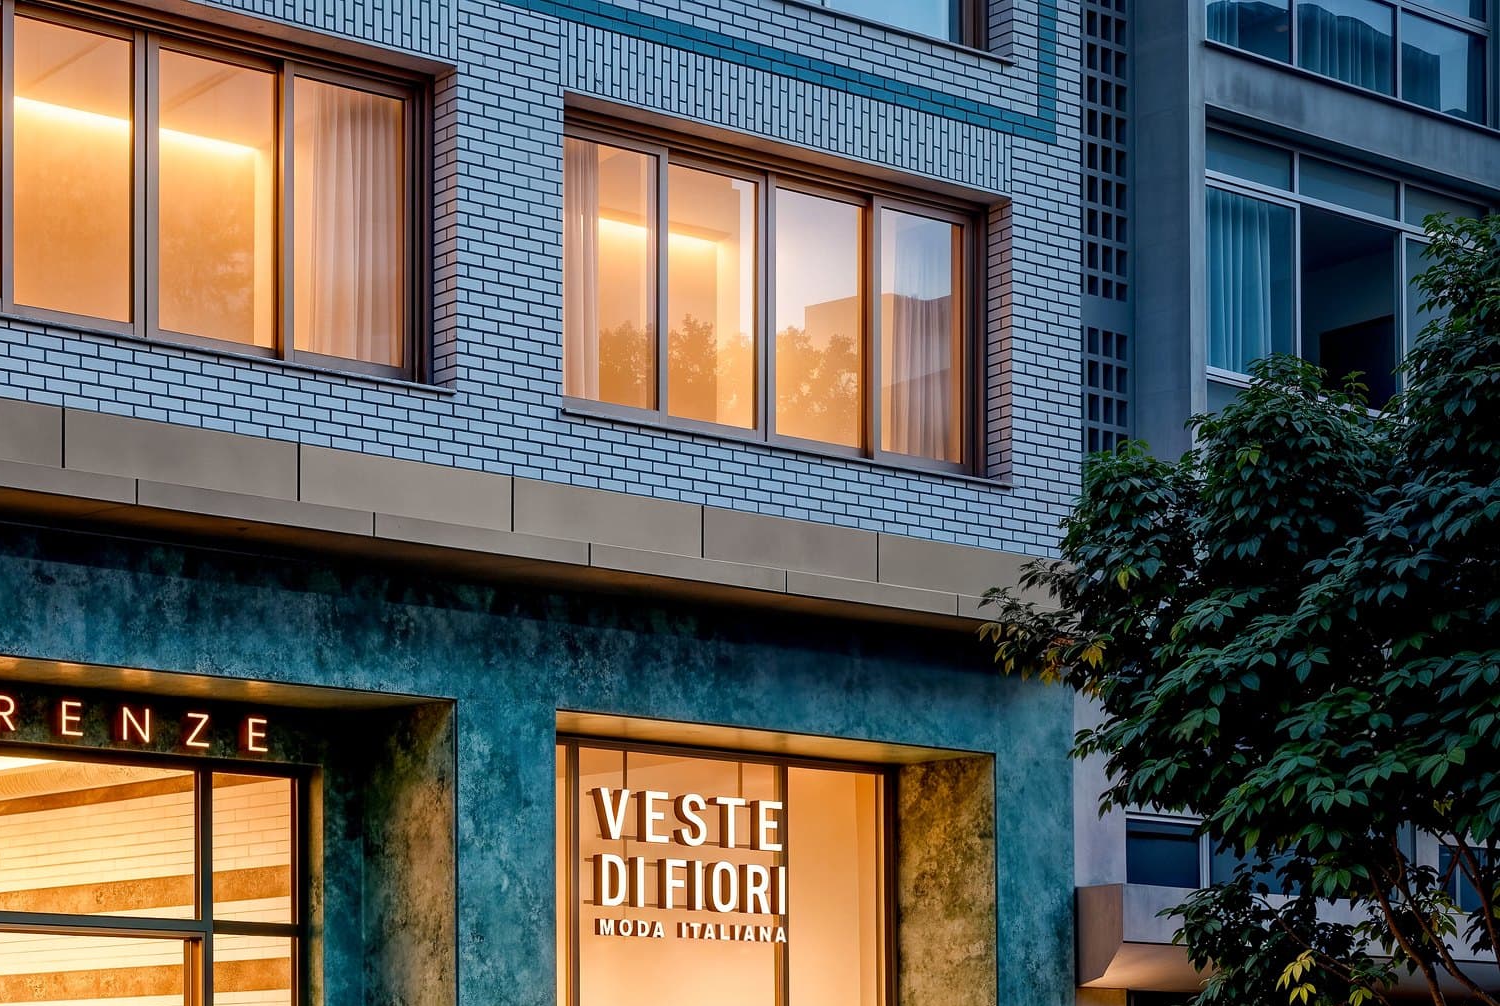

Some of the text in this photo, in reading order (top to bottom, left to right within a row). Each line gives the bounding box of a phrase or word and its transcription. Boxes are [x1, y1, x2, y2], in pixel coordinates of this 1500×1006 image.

[597, 787, 783, 852] VESTE
[599, 853, 786, 915] DI FIORI
[598, 918, 787, 943] MODA ITALIANA
